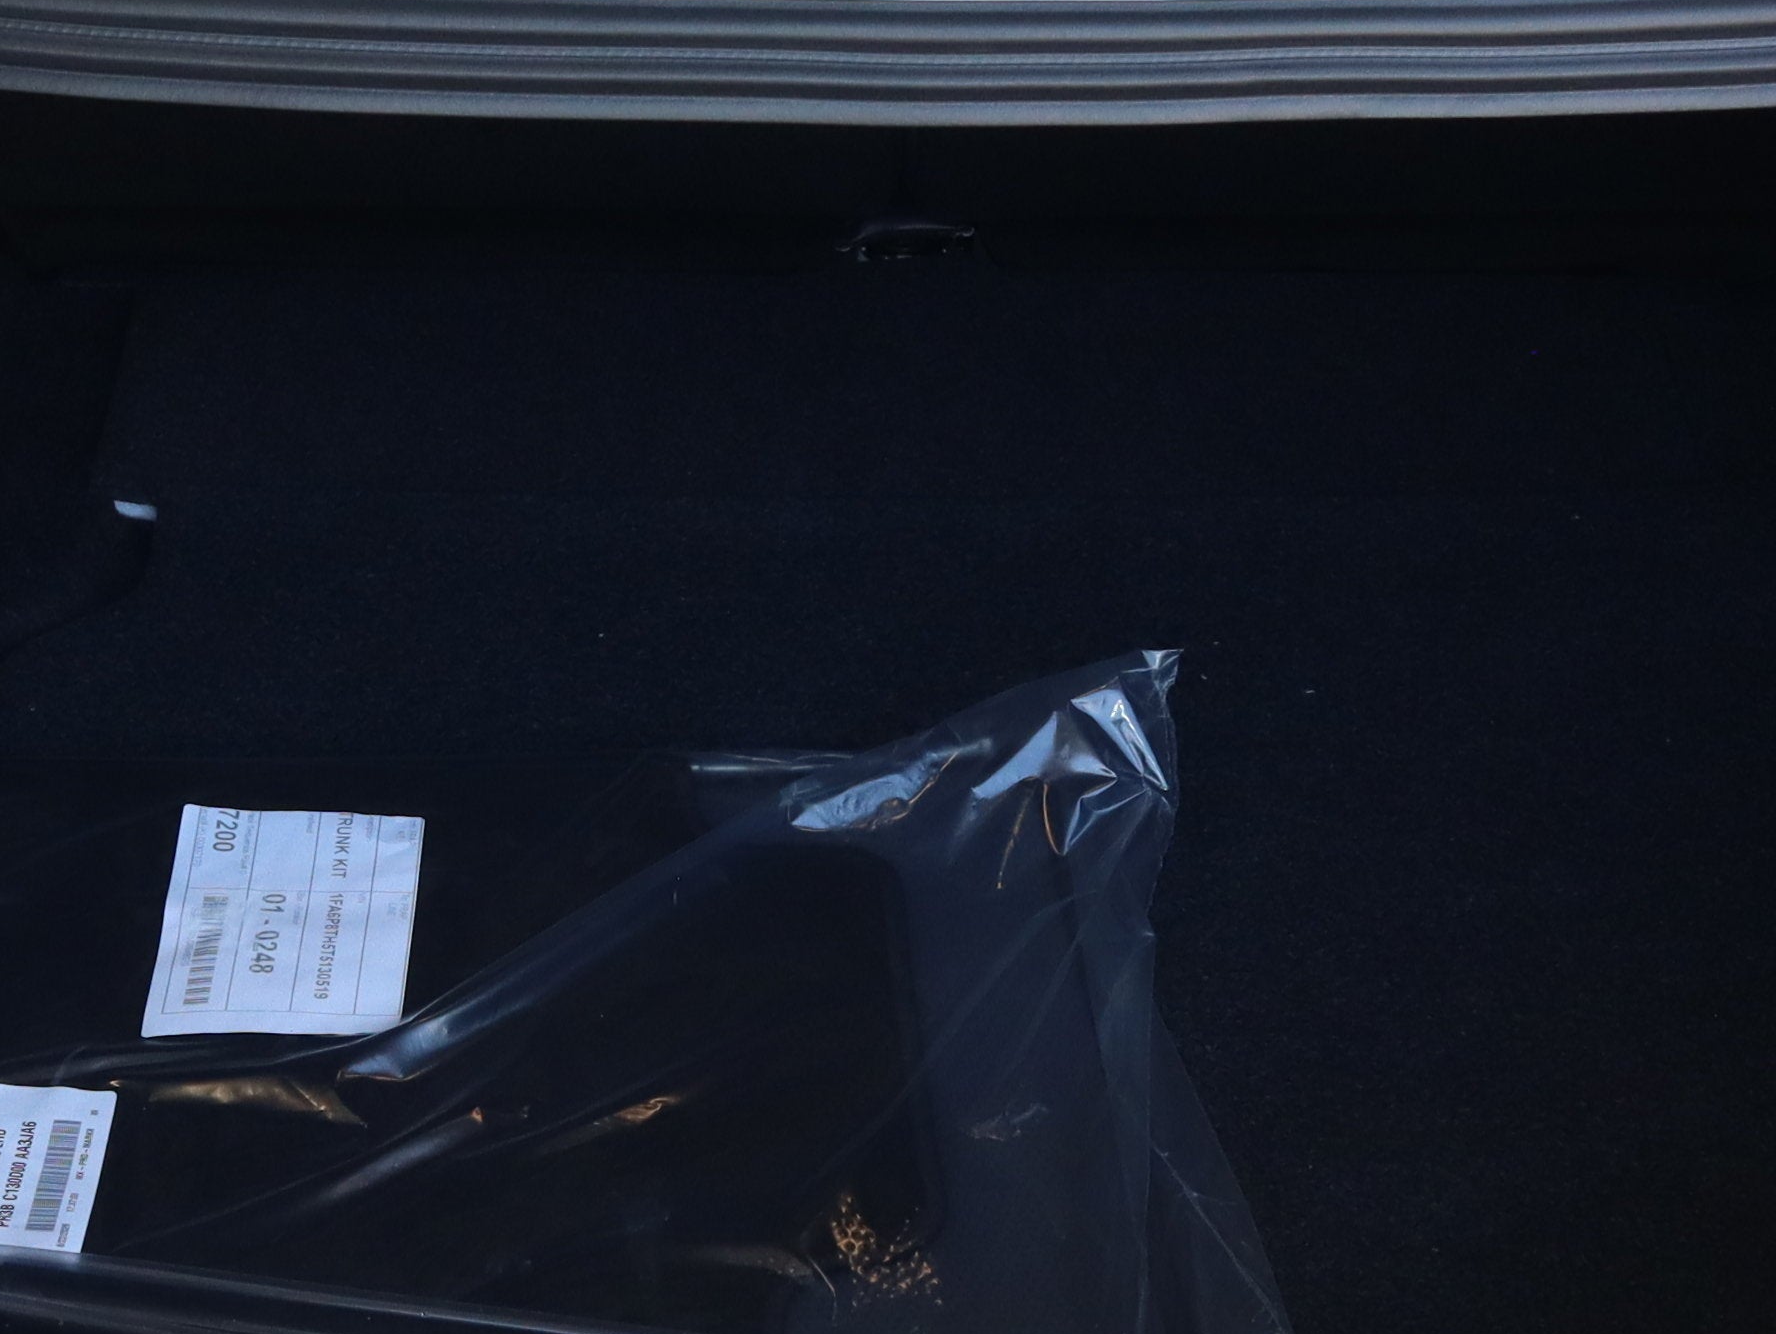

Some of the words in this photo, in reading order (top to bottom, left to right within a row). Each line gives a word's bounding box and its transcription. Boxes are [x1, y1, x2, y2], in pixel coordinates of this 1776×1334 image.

[212, 810, 241, 852] 7200
[331, 858, 348, 879] KIT
[262, 893, 287, 914] 01
[248, 930, 279, 975] 0248
[15, 1120, 38, 1159] AA3JA6
